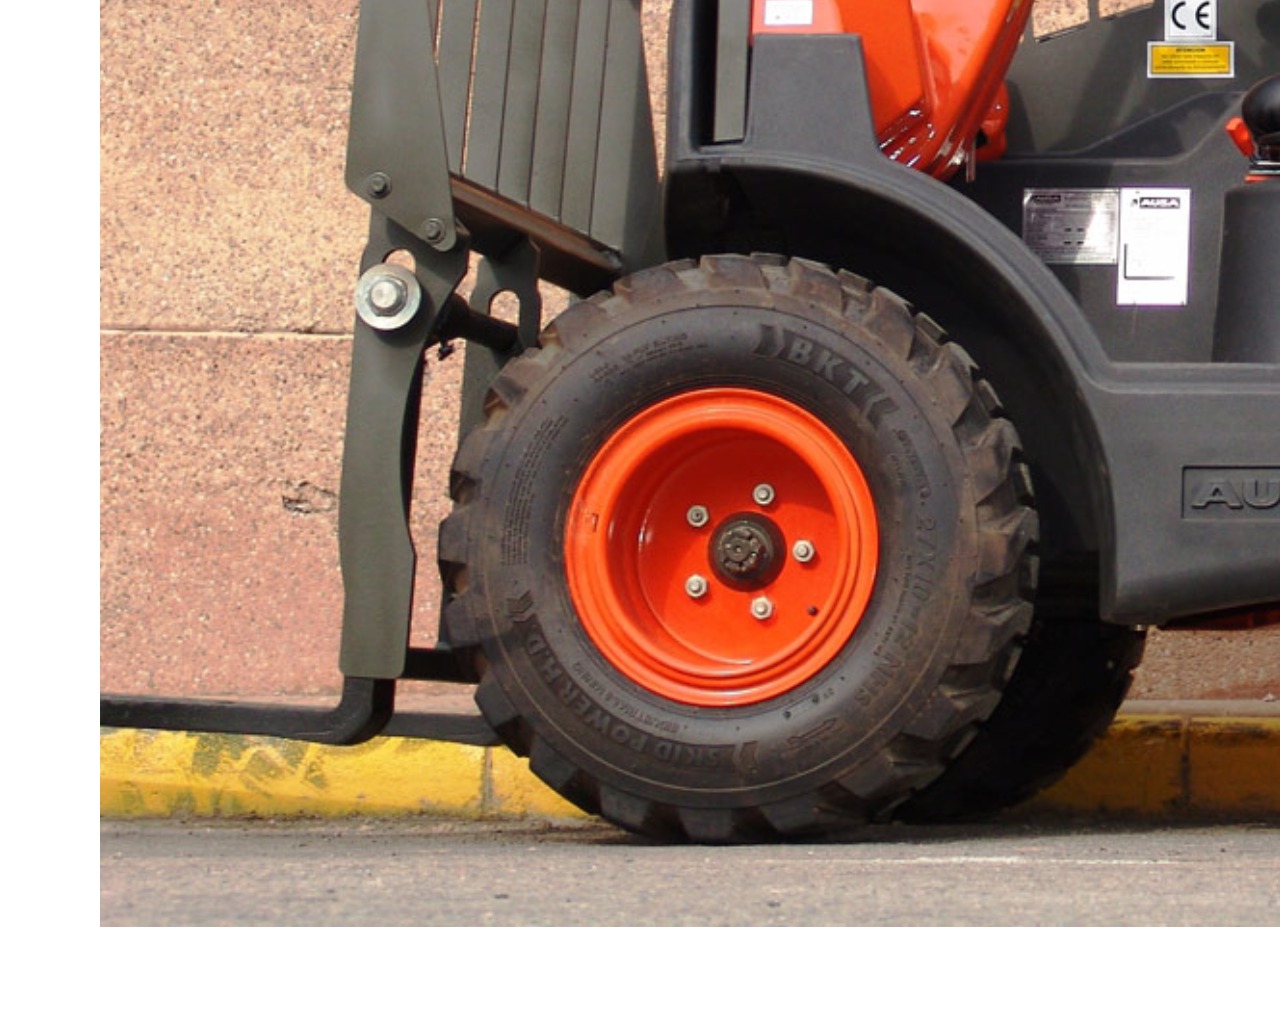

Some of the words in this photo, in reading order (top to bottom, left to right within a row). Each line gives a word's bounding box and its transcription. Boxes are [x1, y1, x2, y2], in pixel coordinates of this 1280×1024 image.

[1171, 0, 1210, 30] CE
[1140, 197, 1180, 208] AUSA
[788, 337, 869, 395] BKT
[558, 681, 648, 754] POWER
[651, 738, 718, 770] SKID
